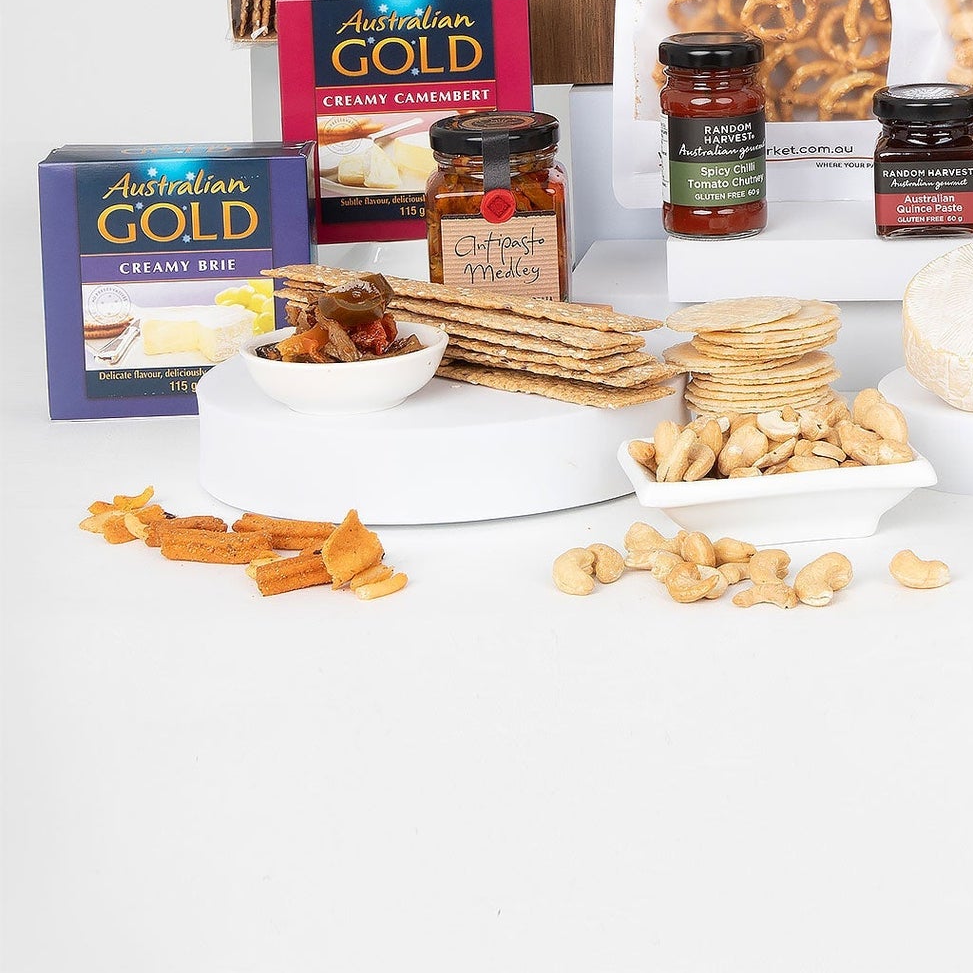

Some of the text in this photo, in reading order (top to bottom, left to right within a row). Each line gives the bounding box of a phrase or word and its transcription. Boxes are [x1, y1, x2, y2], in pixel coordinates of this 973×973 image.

[336, 5, 475, 35] Australian
[331, 35, 483, 77] GOLD
[323, 89, 490, 107] CREAMY CAMEMBERT
[704, 123, 751, 134] RANDOM
[679, 143, 738, 157] Australian
[701, 162, 755, 177] Spicy Chilli
[102, 169, 250, 199] Australian
[688, 174, 764, 189] Tomato Chutney
[890, 178, 934, 188] Australian
[340, 197, 362, 206] Subtle
[695, 191, 746, 201] GLUTEN FREE
[904, 194, 955, 203] Australian
[400, 206, 426, 217] 115 g
[896, 203, 963, 214] Quince Paste
[97, 200, 259, 244] GOLD
[119, 259, 236, 275] CREAMY BRIE
[464, 258, 540, 284] Medley
[99, 371, 132, 380] Delicate
[169, 380, 188, 391] 115
